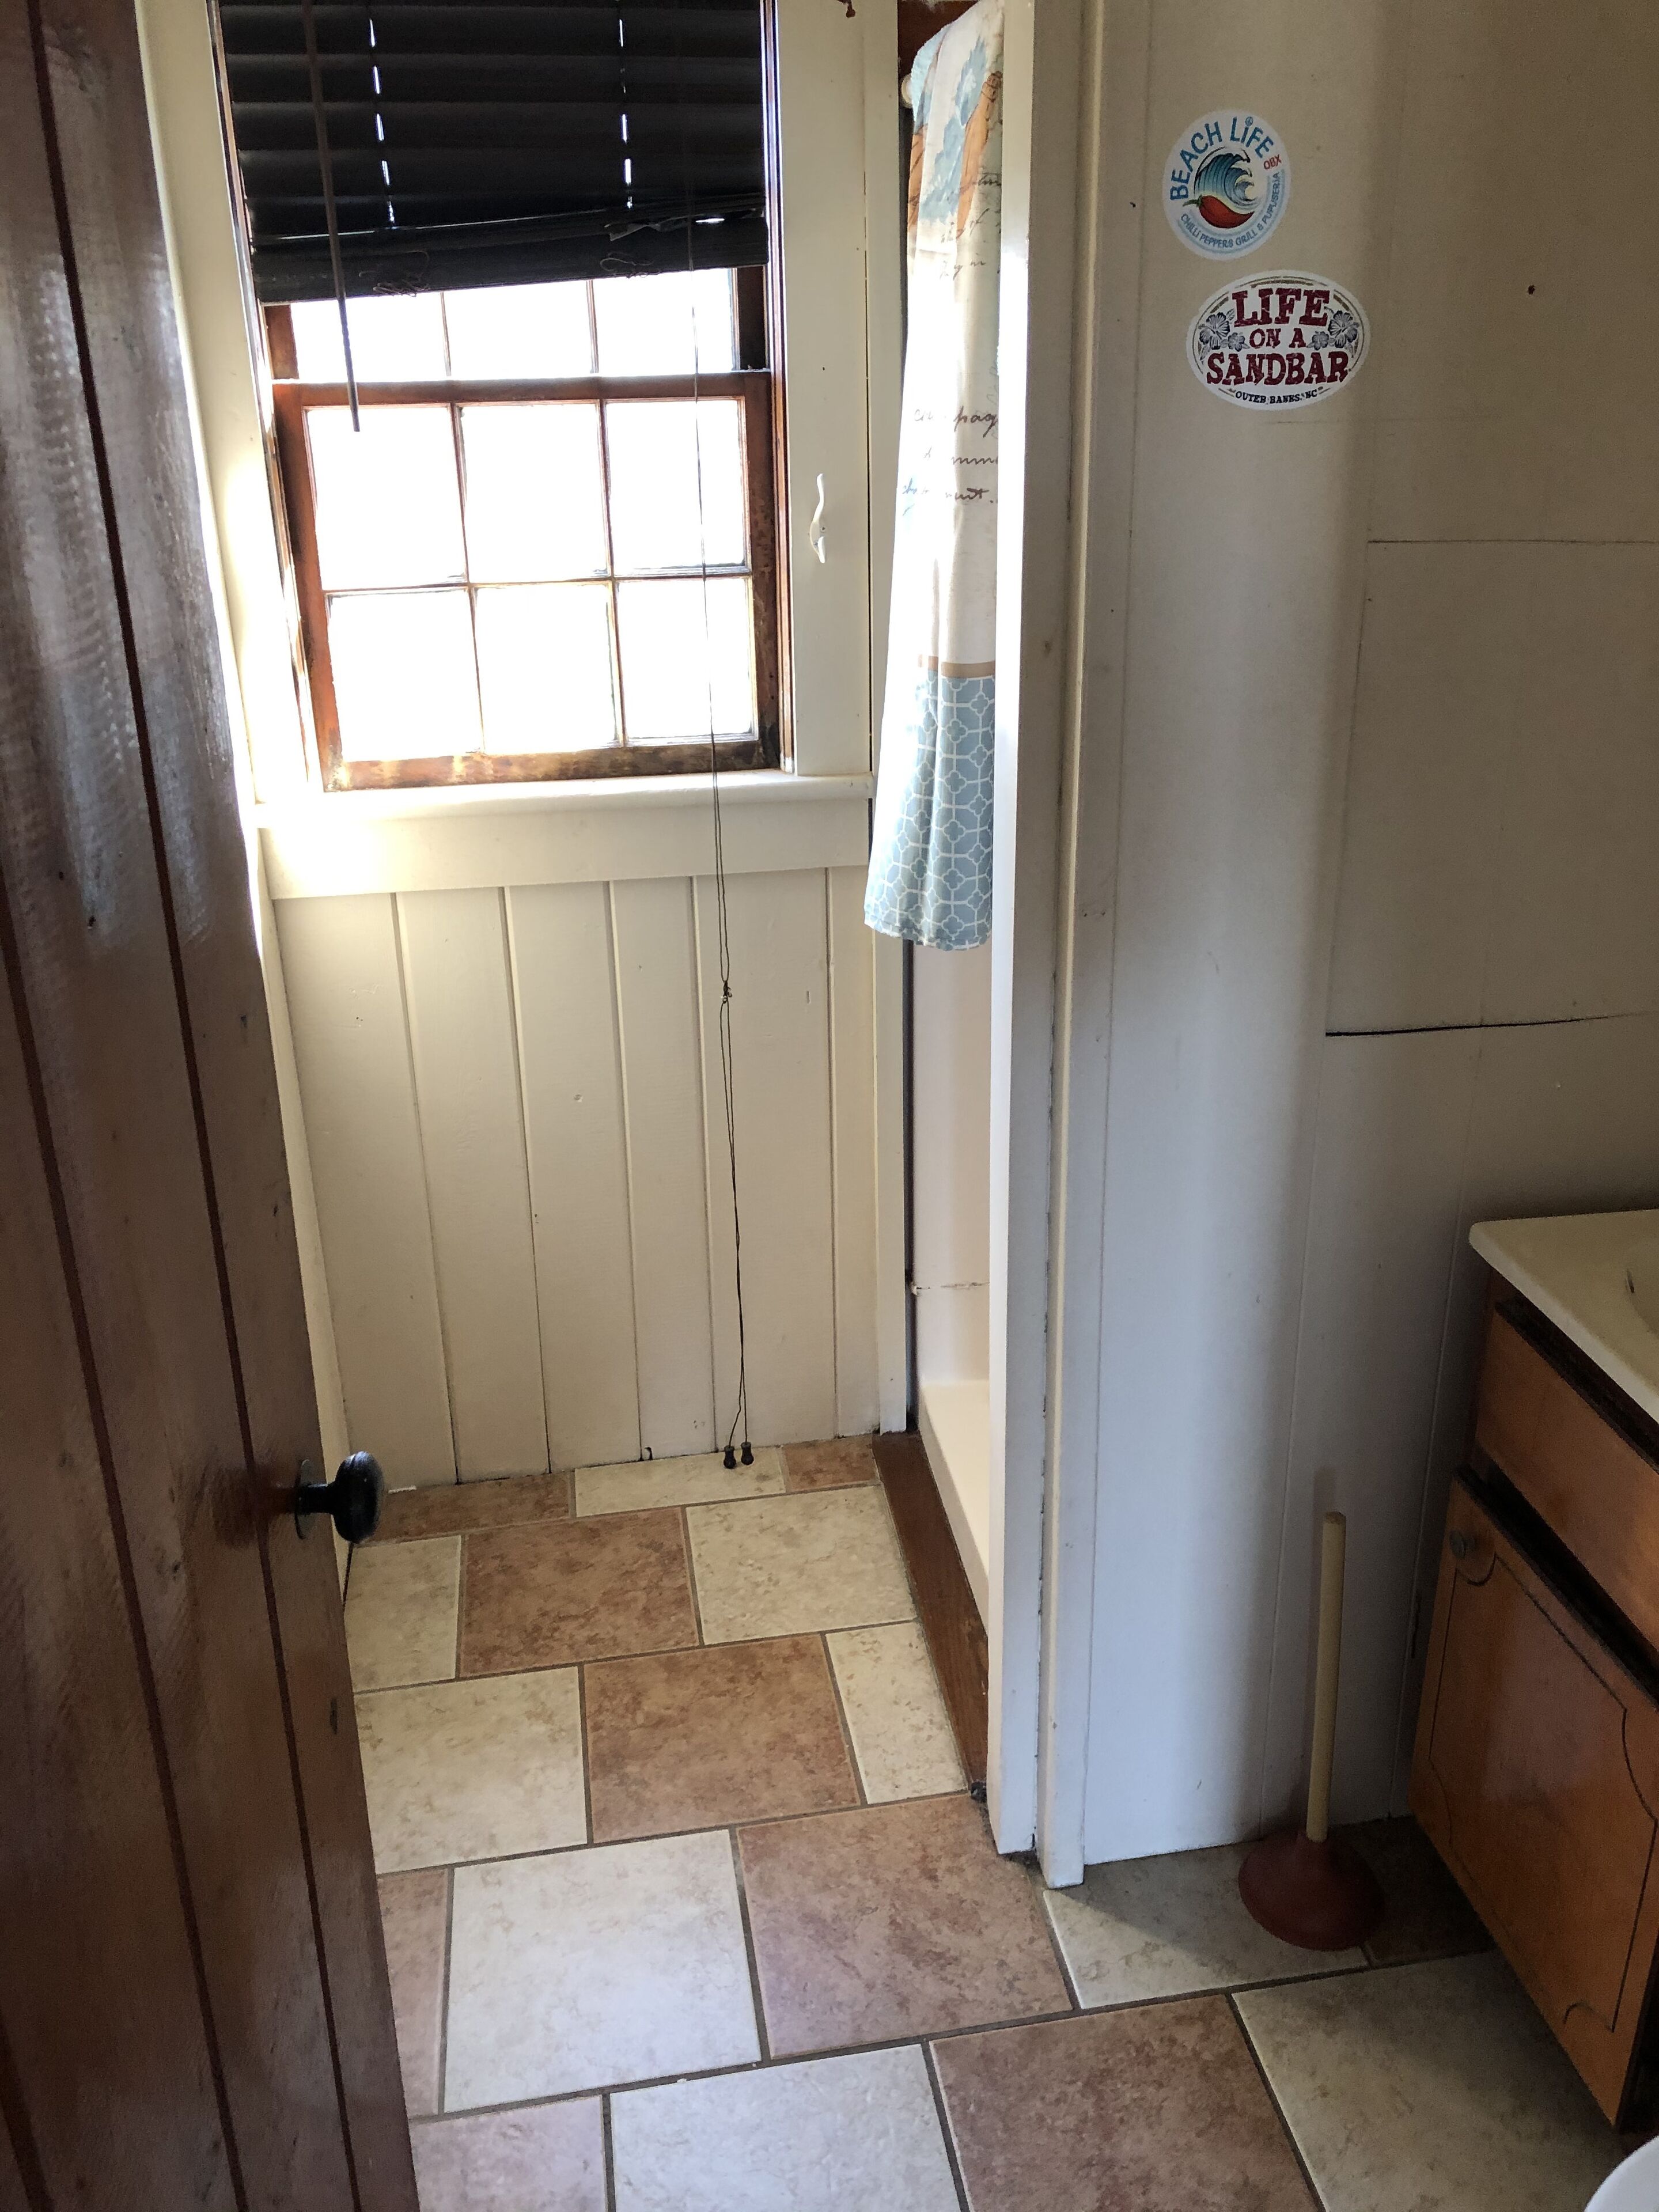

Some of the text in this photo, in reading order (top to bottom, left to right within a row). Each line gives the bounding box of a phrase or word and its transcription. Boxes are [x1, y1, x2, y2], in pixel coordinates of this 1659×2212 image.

[1169, 121, 1222, 200] BEACH
[1263, 154, 1282, 171] OBX
[1199, 233, 1234, 248] PEPPERS
[1235, 229, 1258, 246] GRILL
[1232, 287, 1330, 328] LIFE
[1249, 327, 1306, 349] ON A
[1206, 351, 1349, 386] SANDBAR
[1235, 391, 1267, 403] OUTER
[1305, 389, 1318, 399] NC
